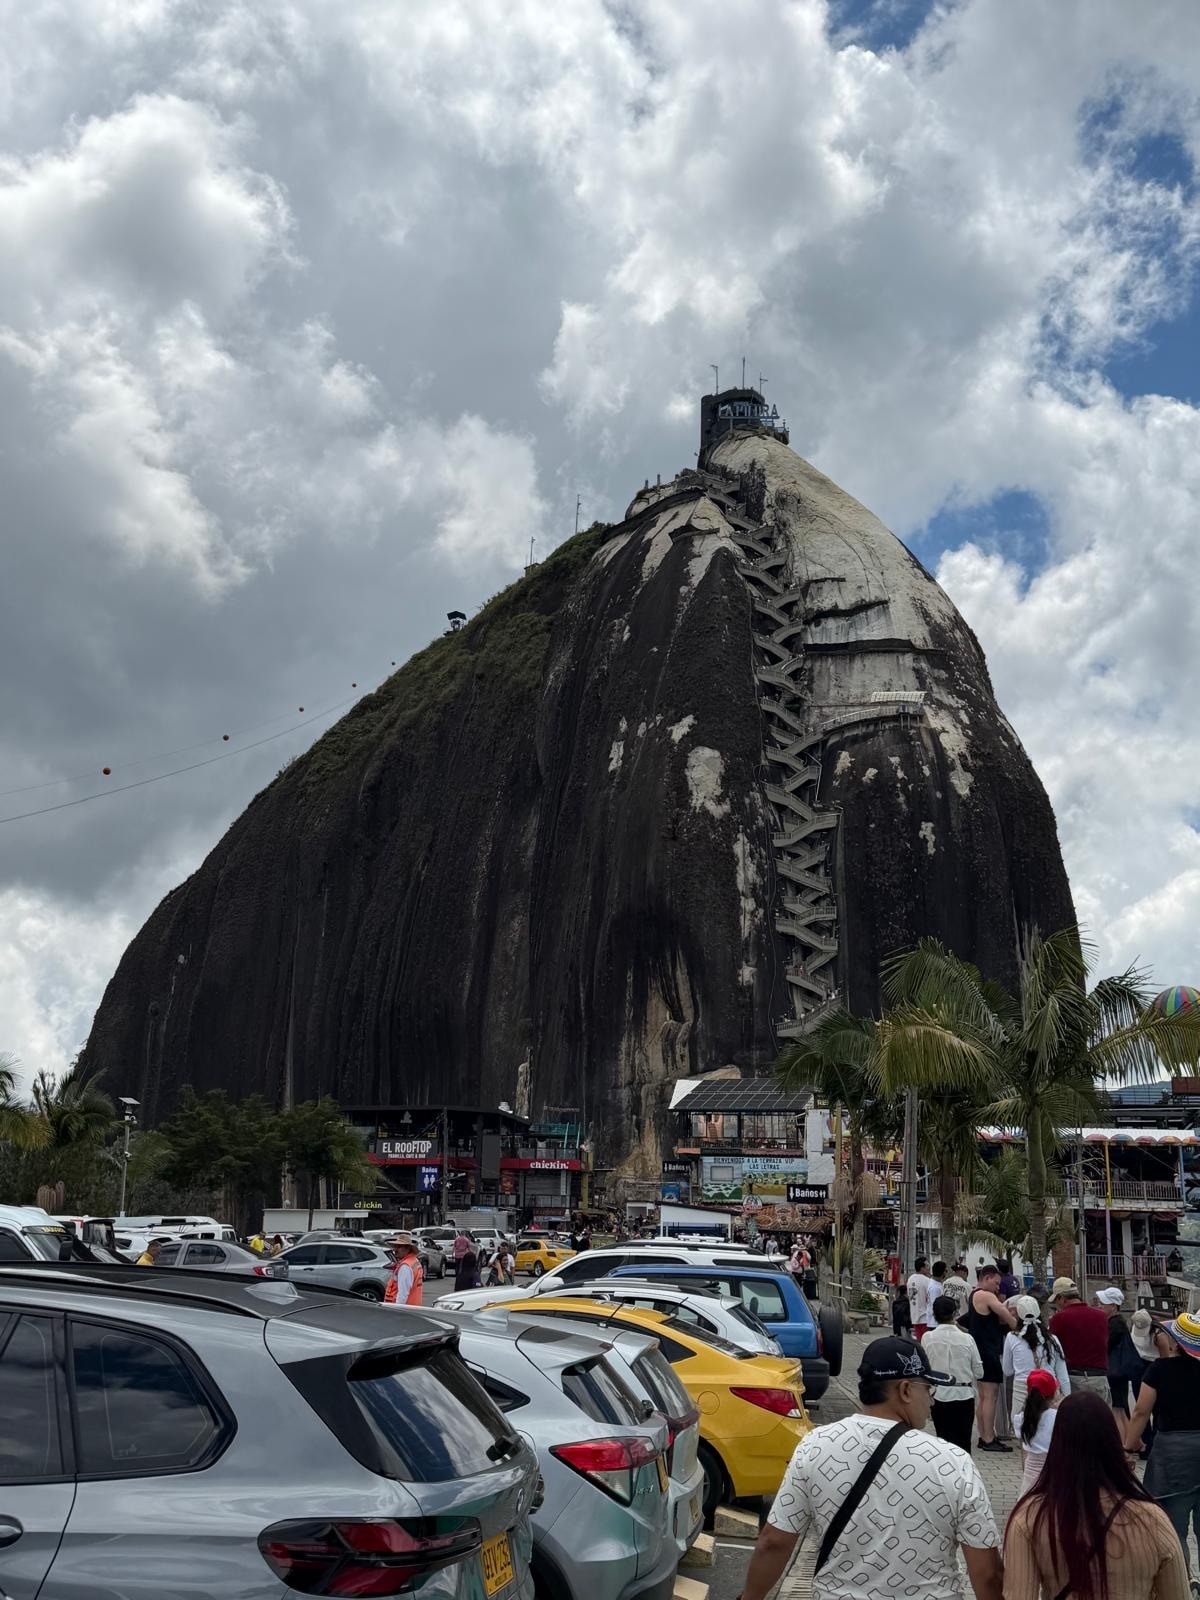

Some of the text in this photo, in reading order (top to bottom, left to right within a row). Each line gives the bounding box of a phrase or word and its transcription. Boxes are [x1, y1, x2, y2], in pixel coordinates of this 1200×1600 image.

[382, 1141, 432, 1153] EL ROOFTOP
[795, 1188, 819, 1198] Baños
